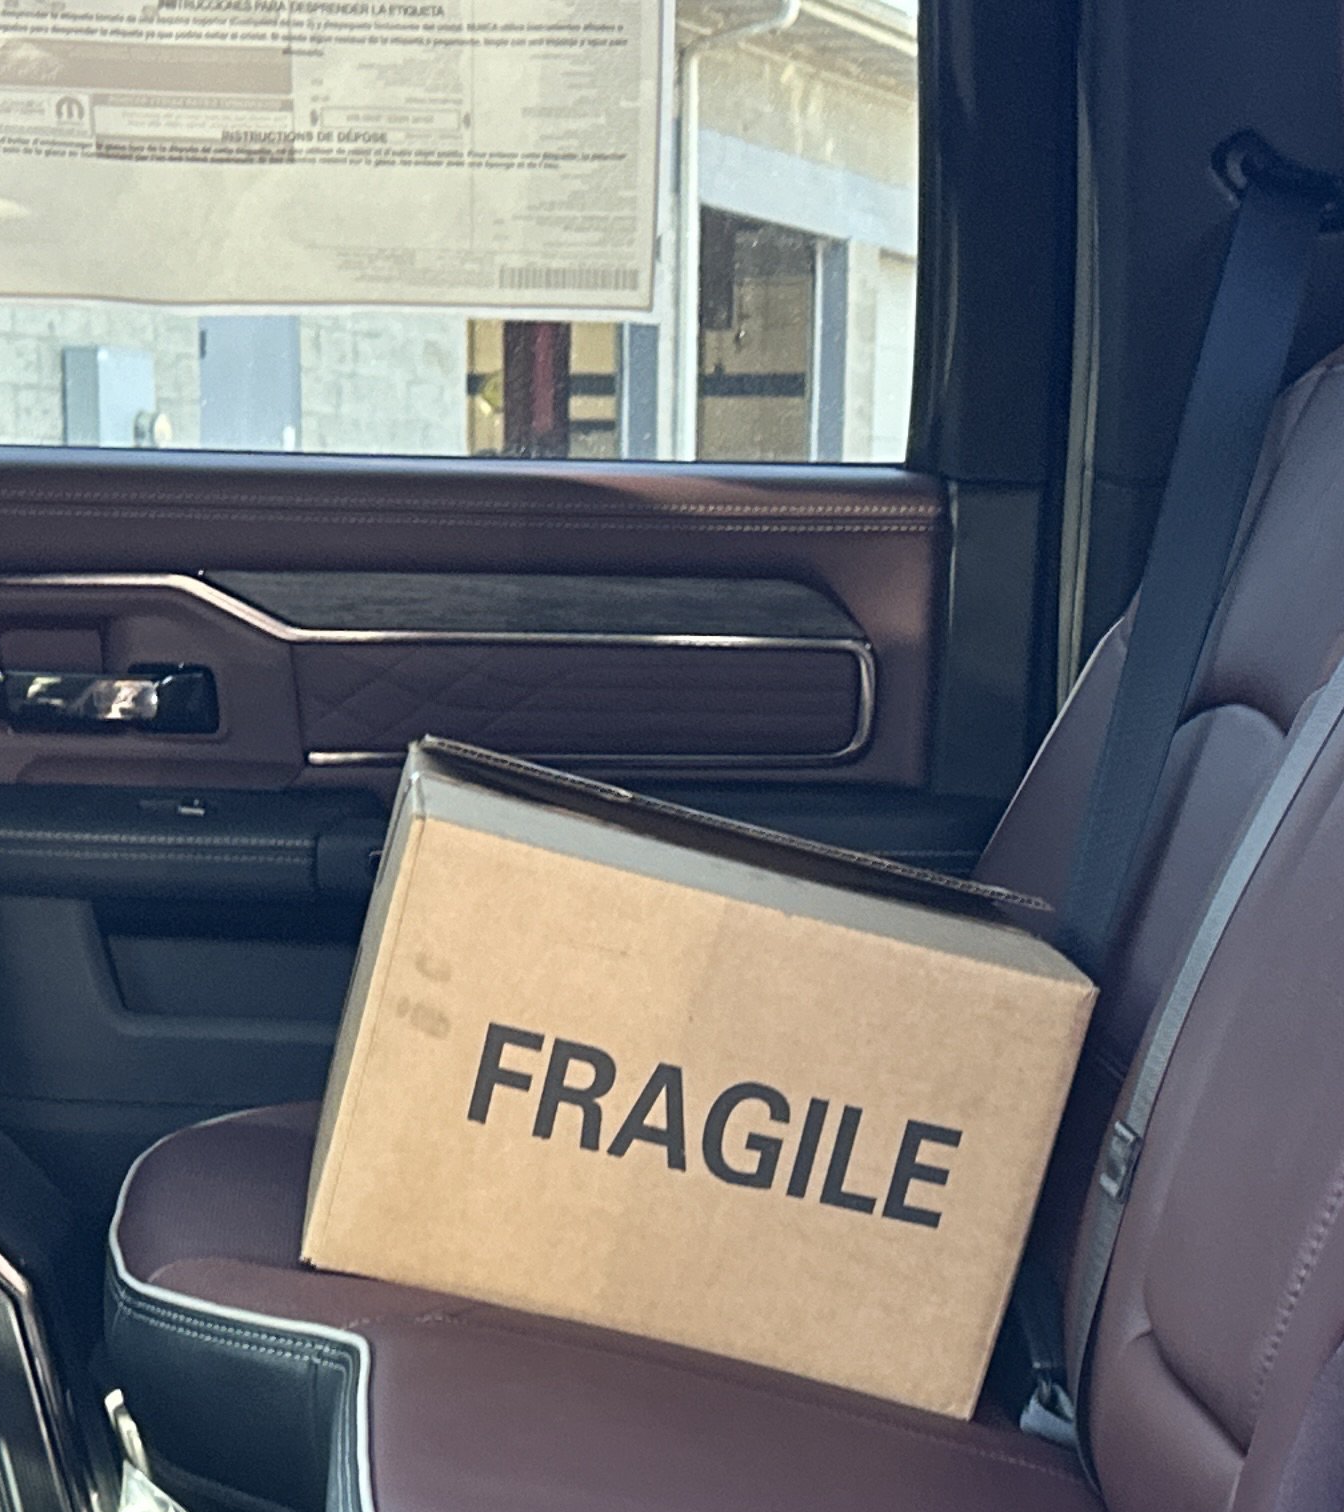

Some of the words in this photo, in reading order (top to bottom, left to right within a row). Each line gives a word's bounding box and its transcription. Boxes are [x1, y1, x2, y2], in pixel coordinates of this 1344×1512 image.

[221, 130, 314, 144] INSTRUCTIONS
[316, 131, 334, 143] DE
[467, 1021, 963, 1229] FRAGILE
